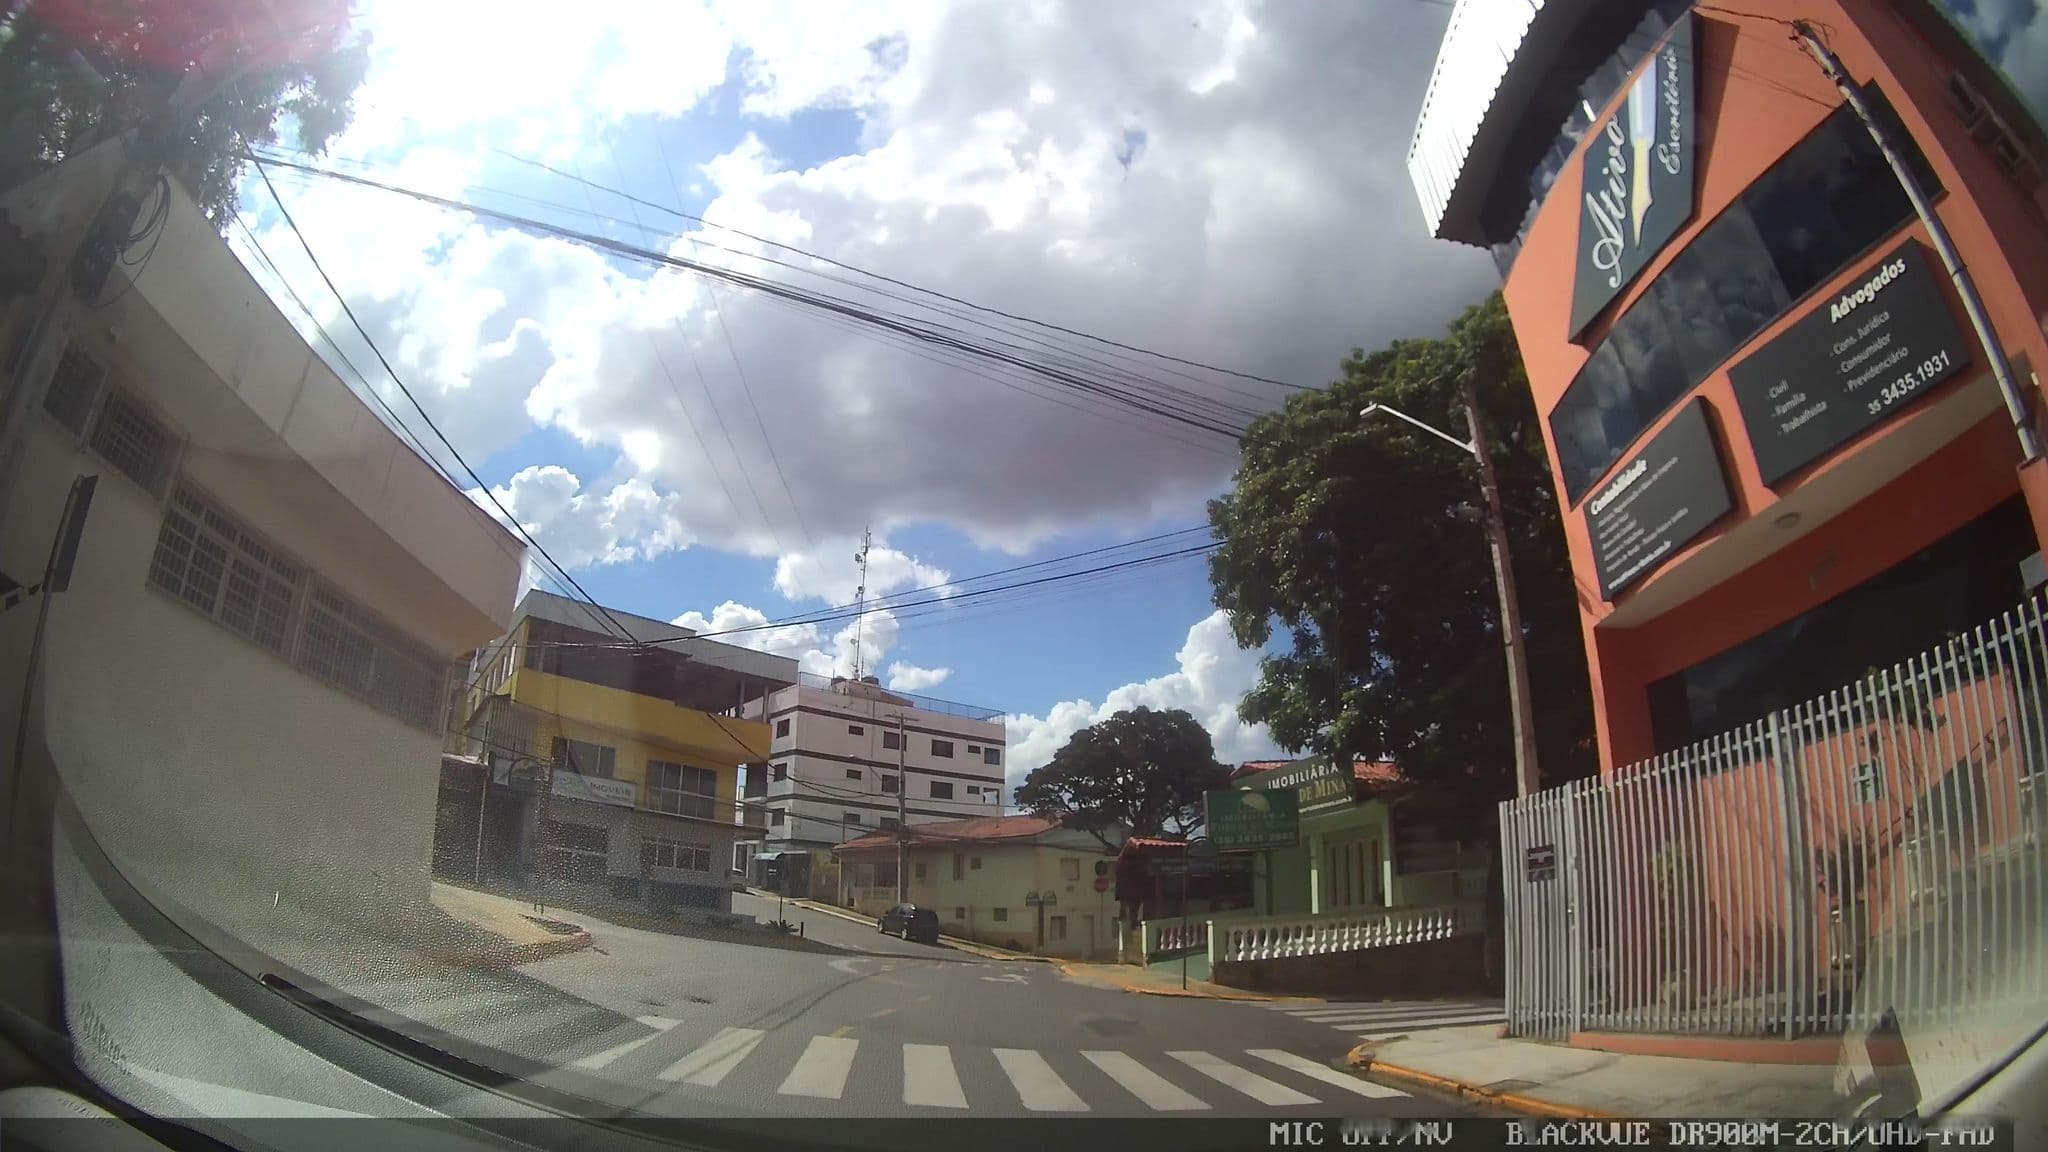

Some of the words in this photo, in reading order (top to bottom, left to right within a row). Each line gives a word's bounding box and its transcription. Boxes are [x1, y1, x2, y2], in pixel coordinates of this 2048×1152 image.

[1585, 112, 1628, 289] Ativo
[1830, 258, 1906, 324] Advogados
[1840, 333, 1892, 373] Consumidor
[1867, 399, 1882, 415] 35
[1880, 349, 1951, 406] 3435.1931
[1268, 761, 1339, 790] IMOBILIÁRIA
[1299, 785, 1312, 802] DE
